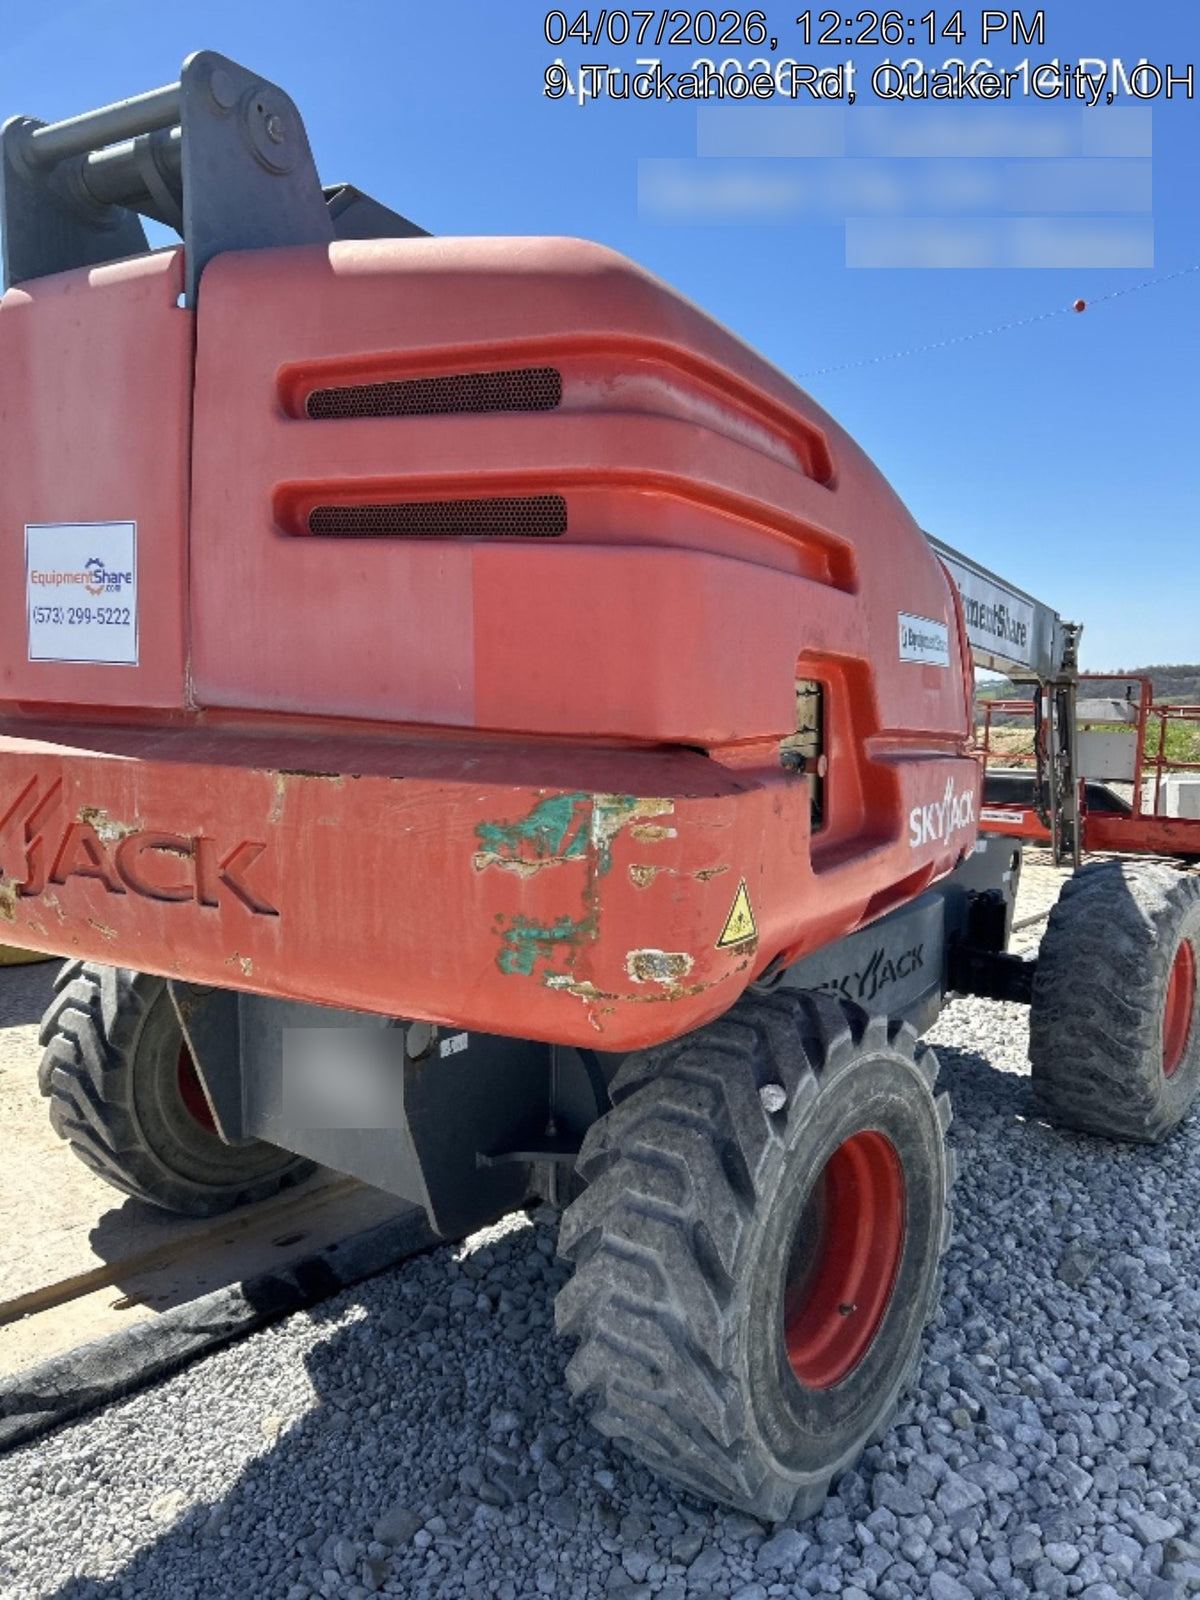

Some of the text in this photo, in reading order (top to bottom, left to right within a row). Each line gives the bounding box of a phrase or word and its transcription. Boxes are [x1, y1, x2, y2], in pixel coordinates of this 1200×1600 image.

[31, 569, 132, 587] EquipmentShare
[33, 606, 131, 626] (573) 299-5222
[908, 776, 975, 849] SKYJACK
[813, 943, 924, 1001] KYJACK
